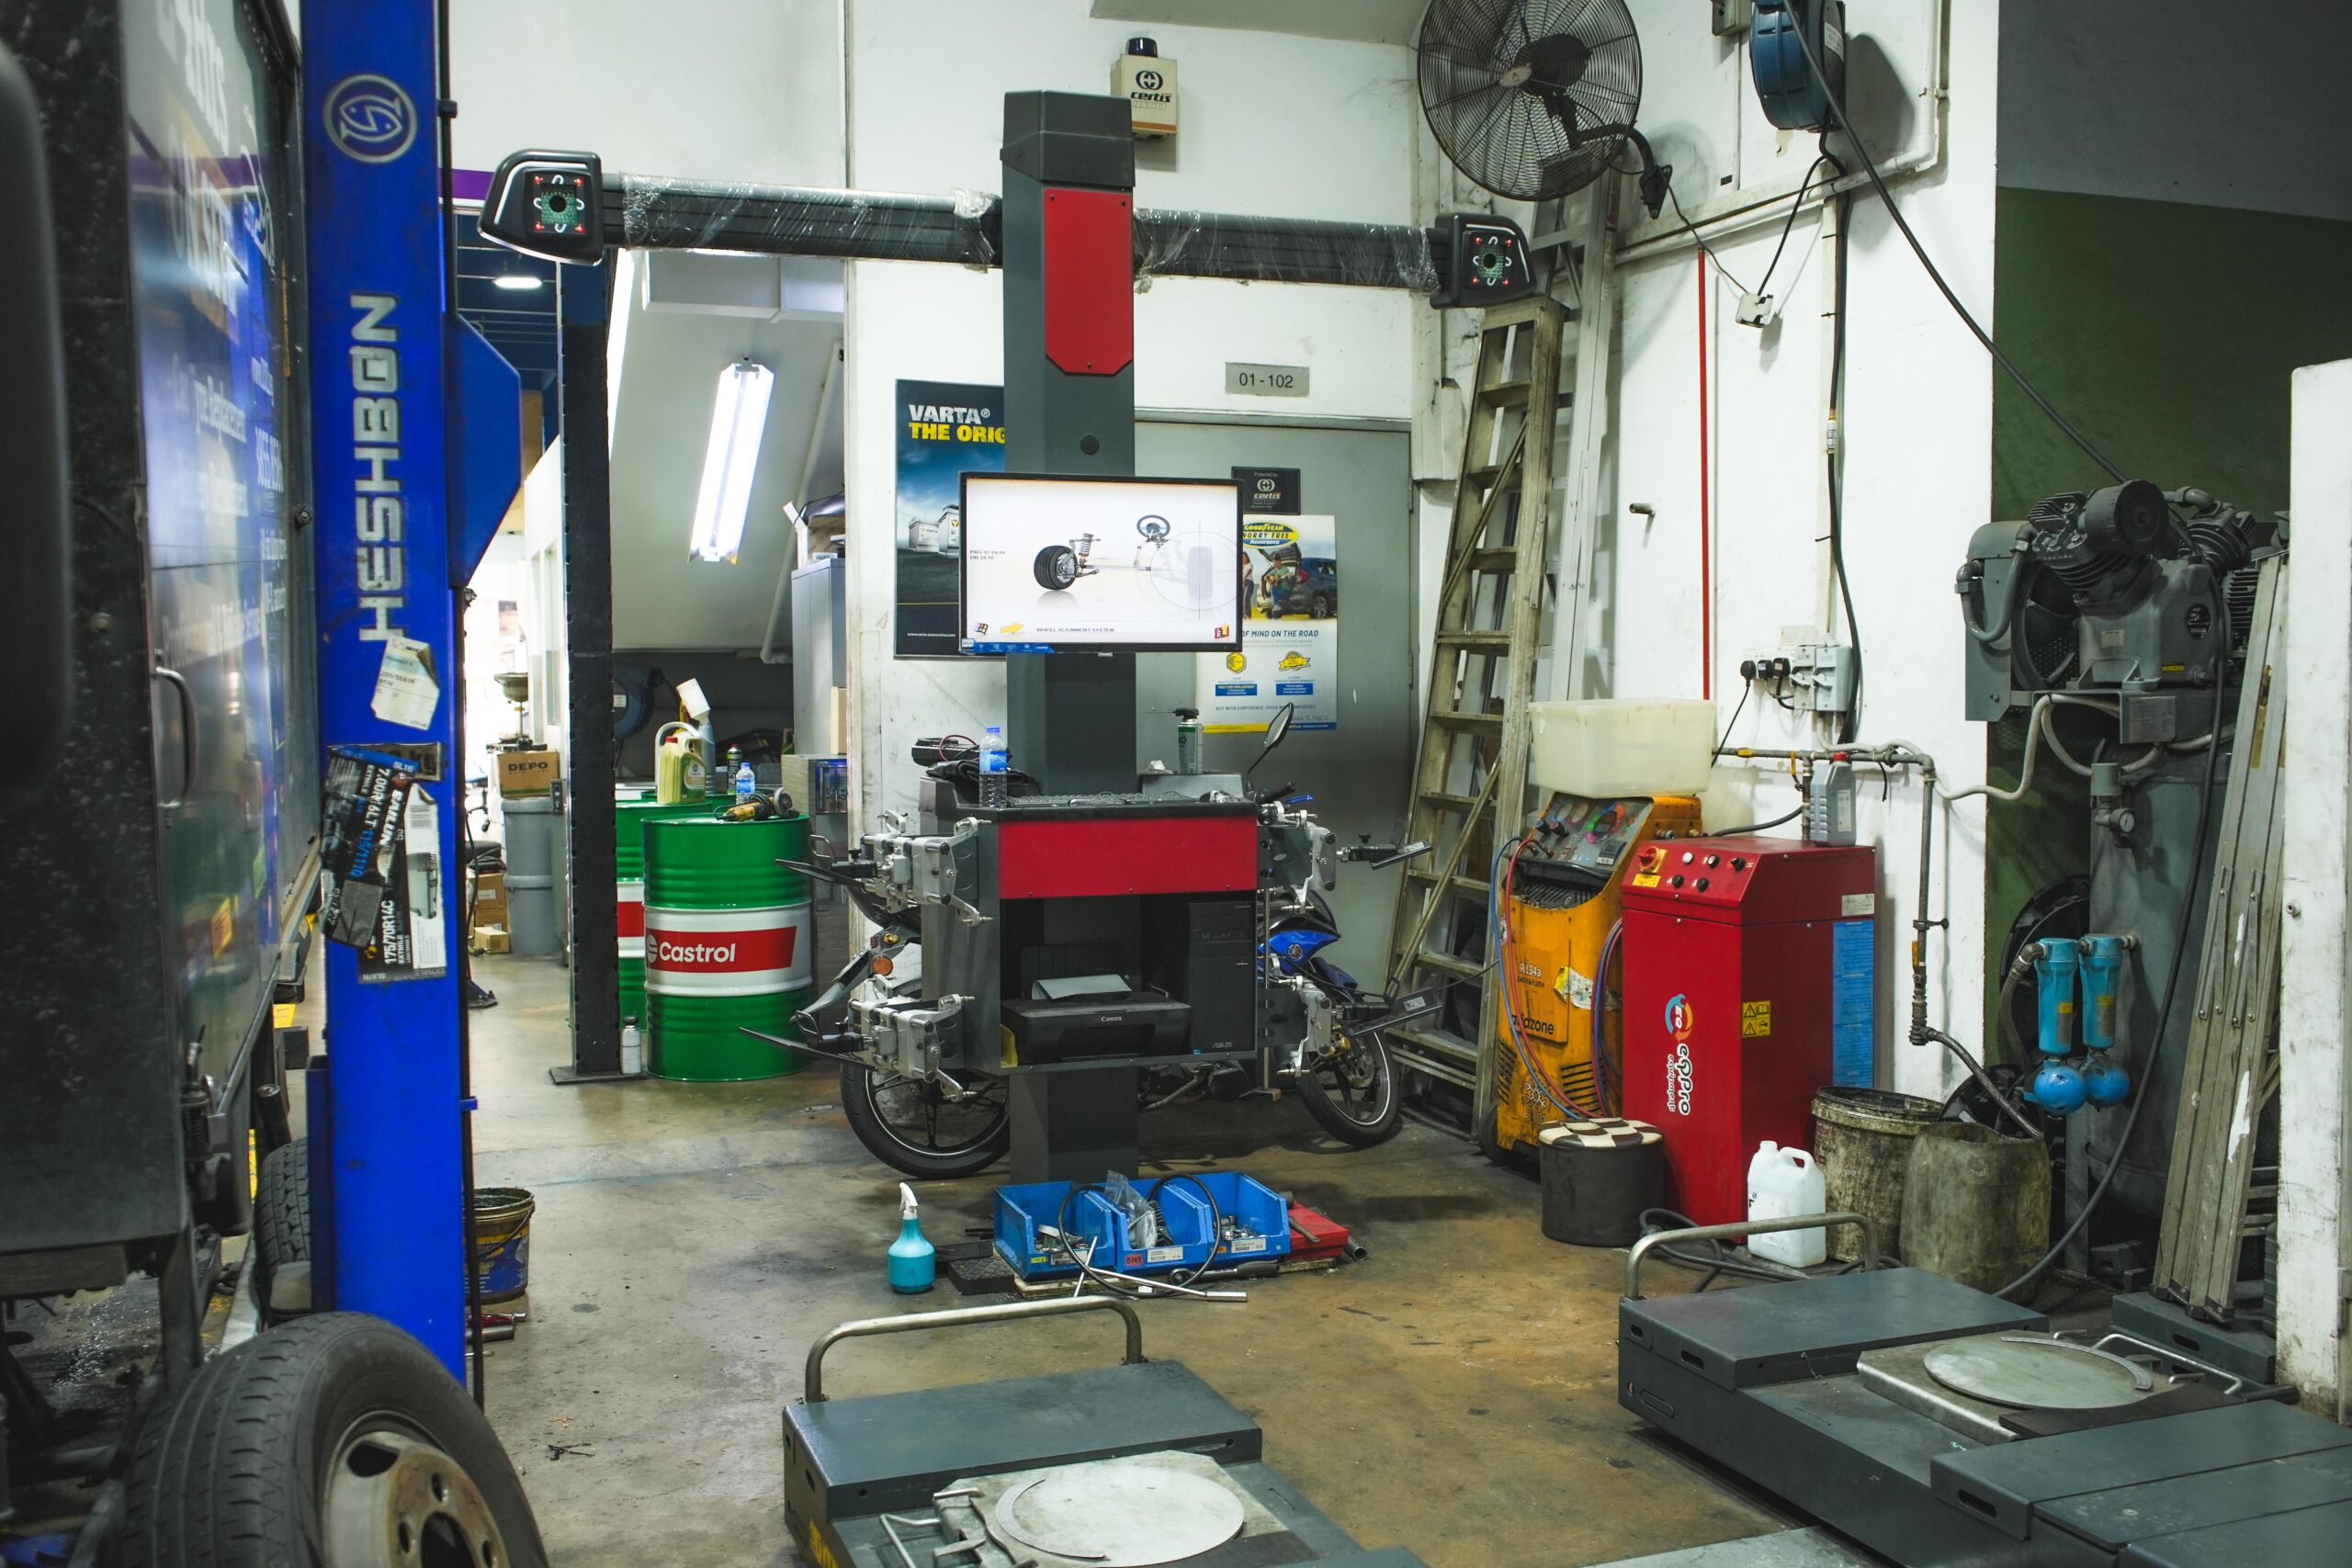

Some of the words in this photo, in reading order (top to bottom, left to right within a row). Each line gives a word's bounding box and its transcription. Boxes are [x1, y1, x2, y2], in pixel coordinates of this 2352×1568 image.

[1131, 92, 1171, 103] certis
[908, 423, 950, 440] THE
[350, 294, 404, 641] HESHBON
[1244, 523, 1284, 532] GOODYEAR
[508, 761, 548, 773] DEPO
[378, 789, 404, 849] SAILUN
[659, 942, 736, 963] Castrol
